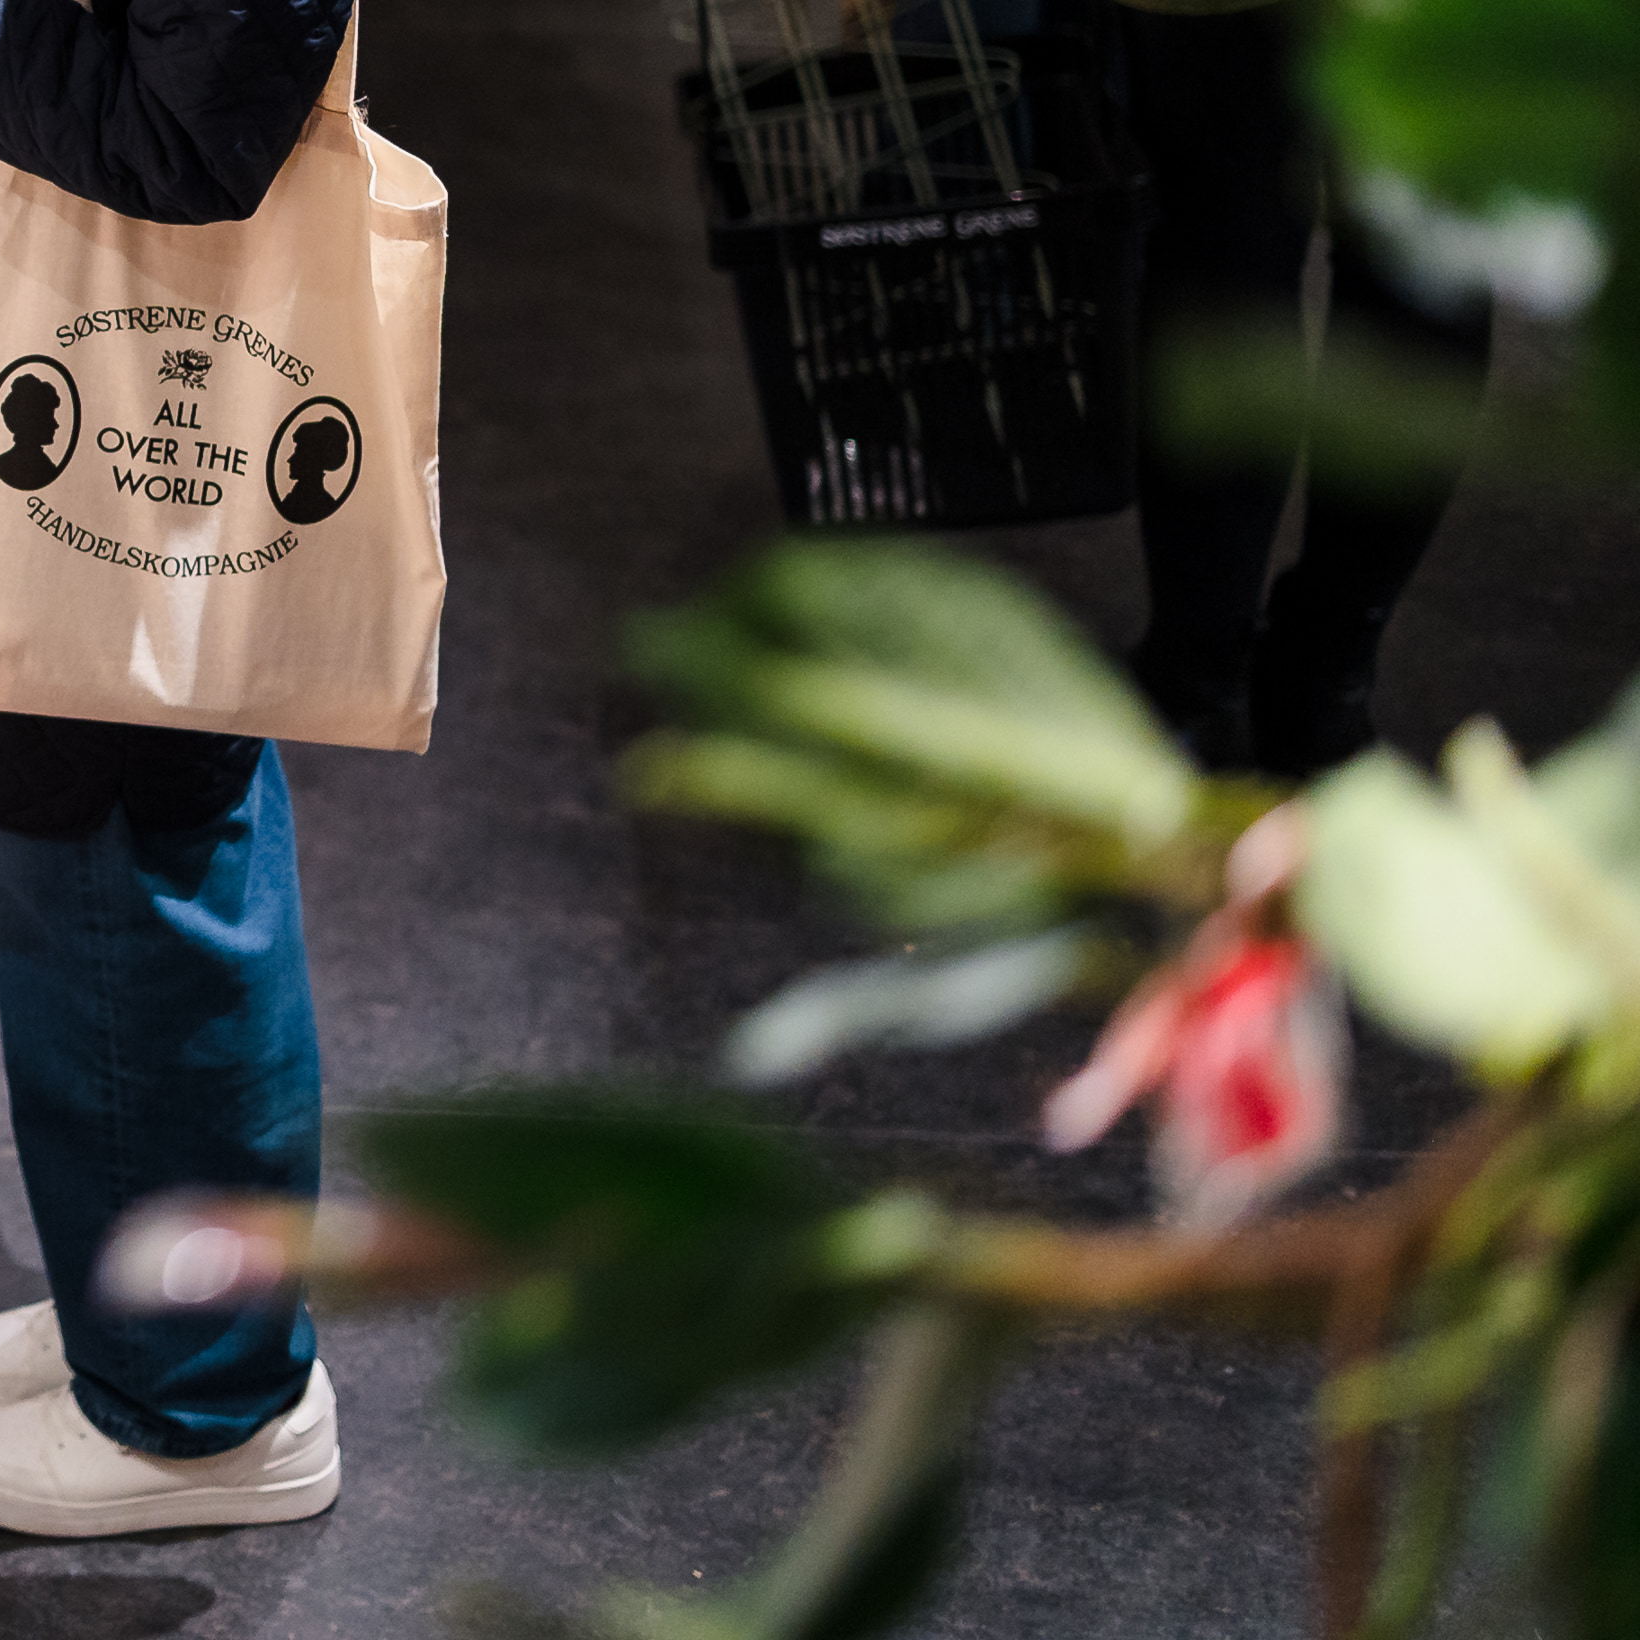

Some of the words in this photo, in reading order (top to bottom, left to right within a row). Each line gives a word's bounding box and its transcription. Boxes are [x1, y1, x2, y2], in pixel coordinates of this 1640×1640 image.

[56, 305, 207, 348] SØSTRENE
[213, 314, 316, 388] GRENES
[153, 398, 203, 431] ALL
[96, 426, 179, 466] OVER
[193, 440, 249, 477] THE
[111, 464, 224, 507] WORLD
[25, 496, 300, 579] HANDELSKOMPAGNIE
